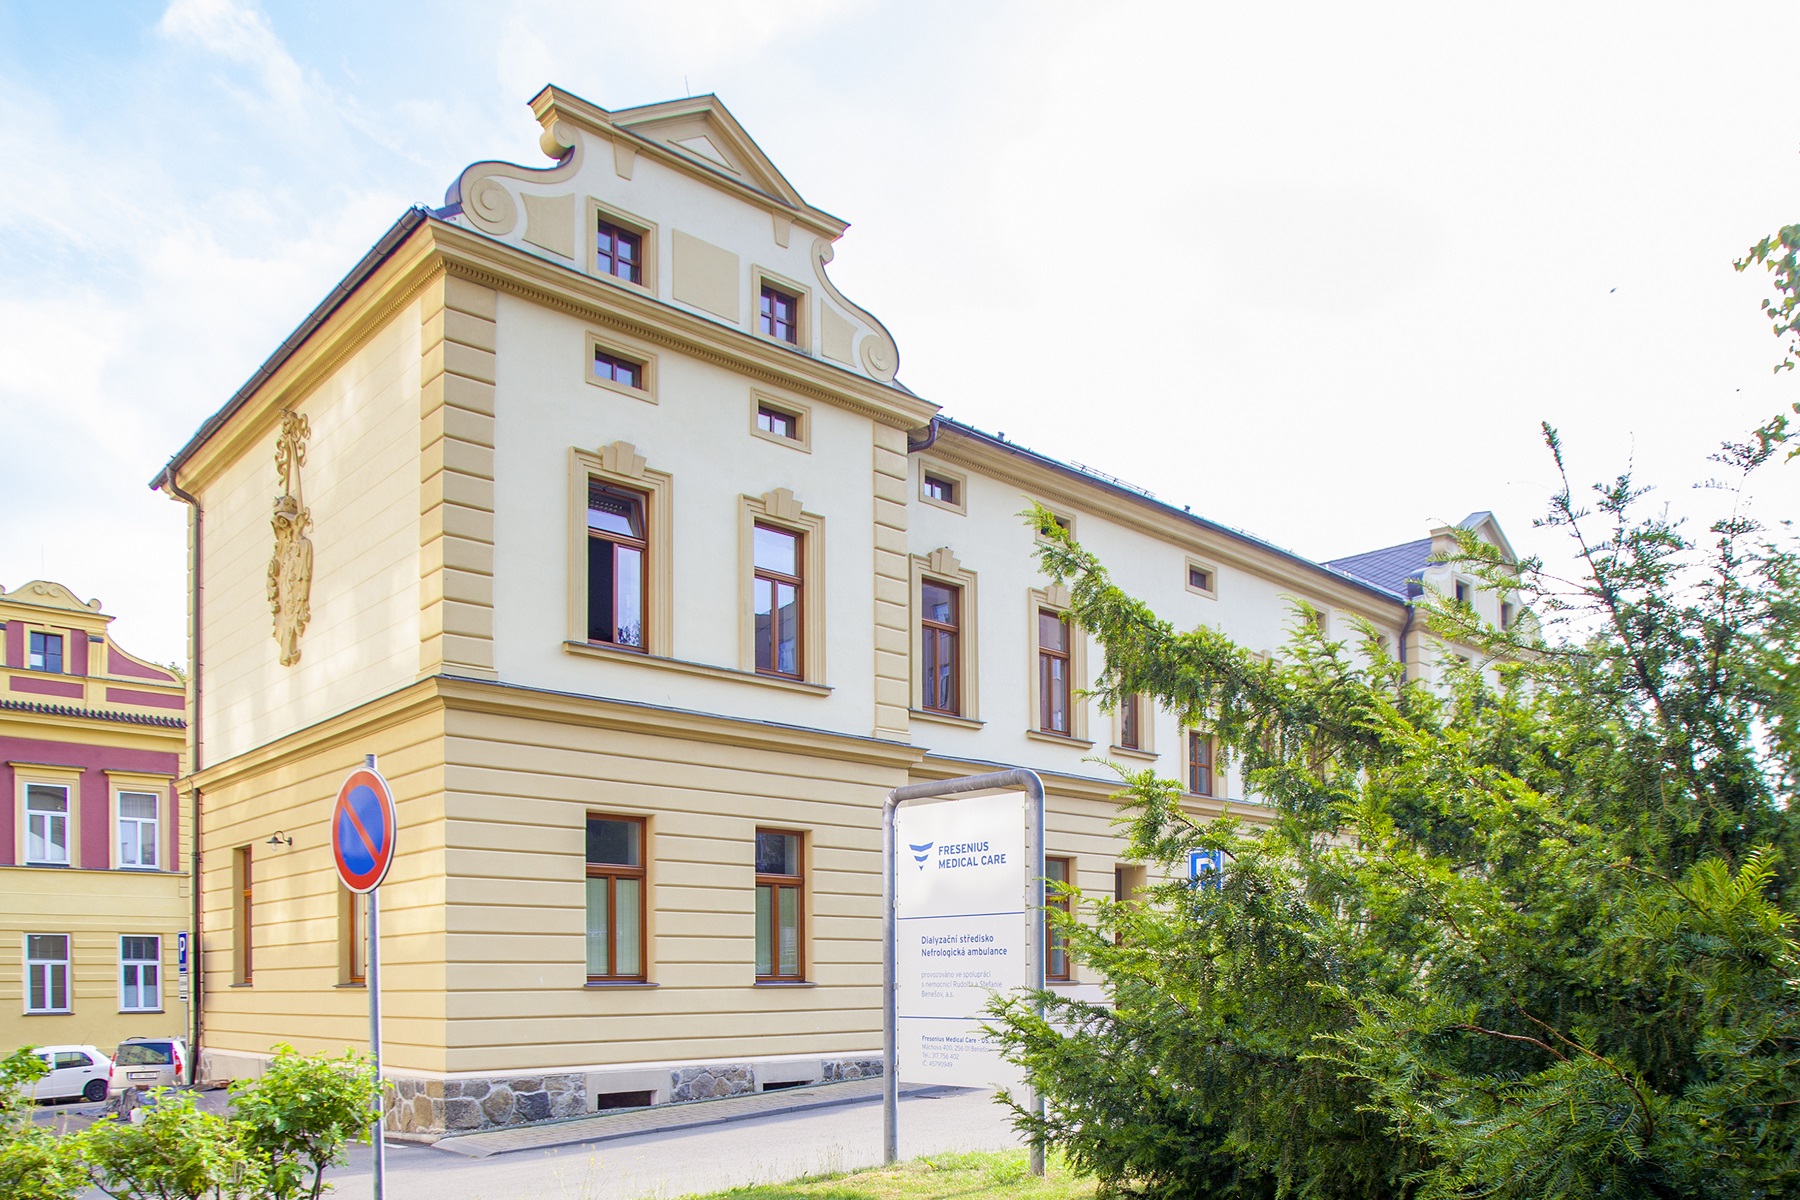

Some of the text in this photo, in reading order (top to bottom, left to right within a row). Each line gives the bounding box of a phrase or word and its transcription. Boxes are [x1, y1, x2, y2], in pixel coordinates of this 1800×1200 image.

[938, 841, 989, 855] FRESENIUS
[938, 853, 1007, 869] MEDICAL CARE
[921, 934, 994, 945] Dialyzační středisko
[179, 937, 186, 960] P
[921, 947, 1008, 958] Nefrologická ambulance
[921, 971, 954, 979] provozováno
[963, 970, 991, 979] spolupráci
[921, 1035, 945, 1043] Fresenius
